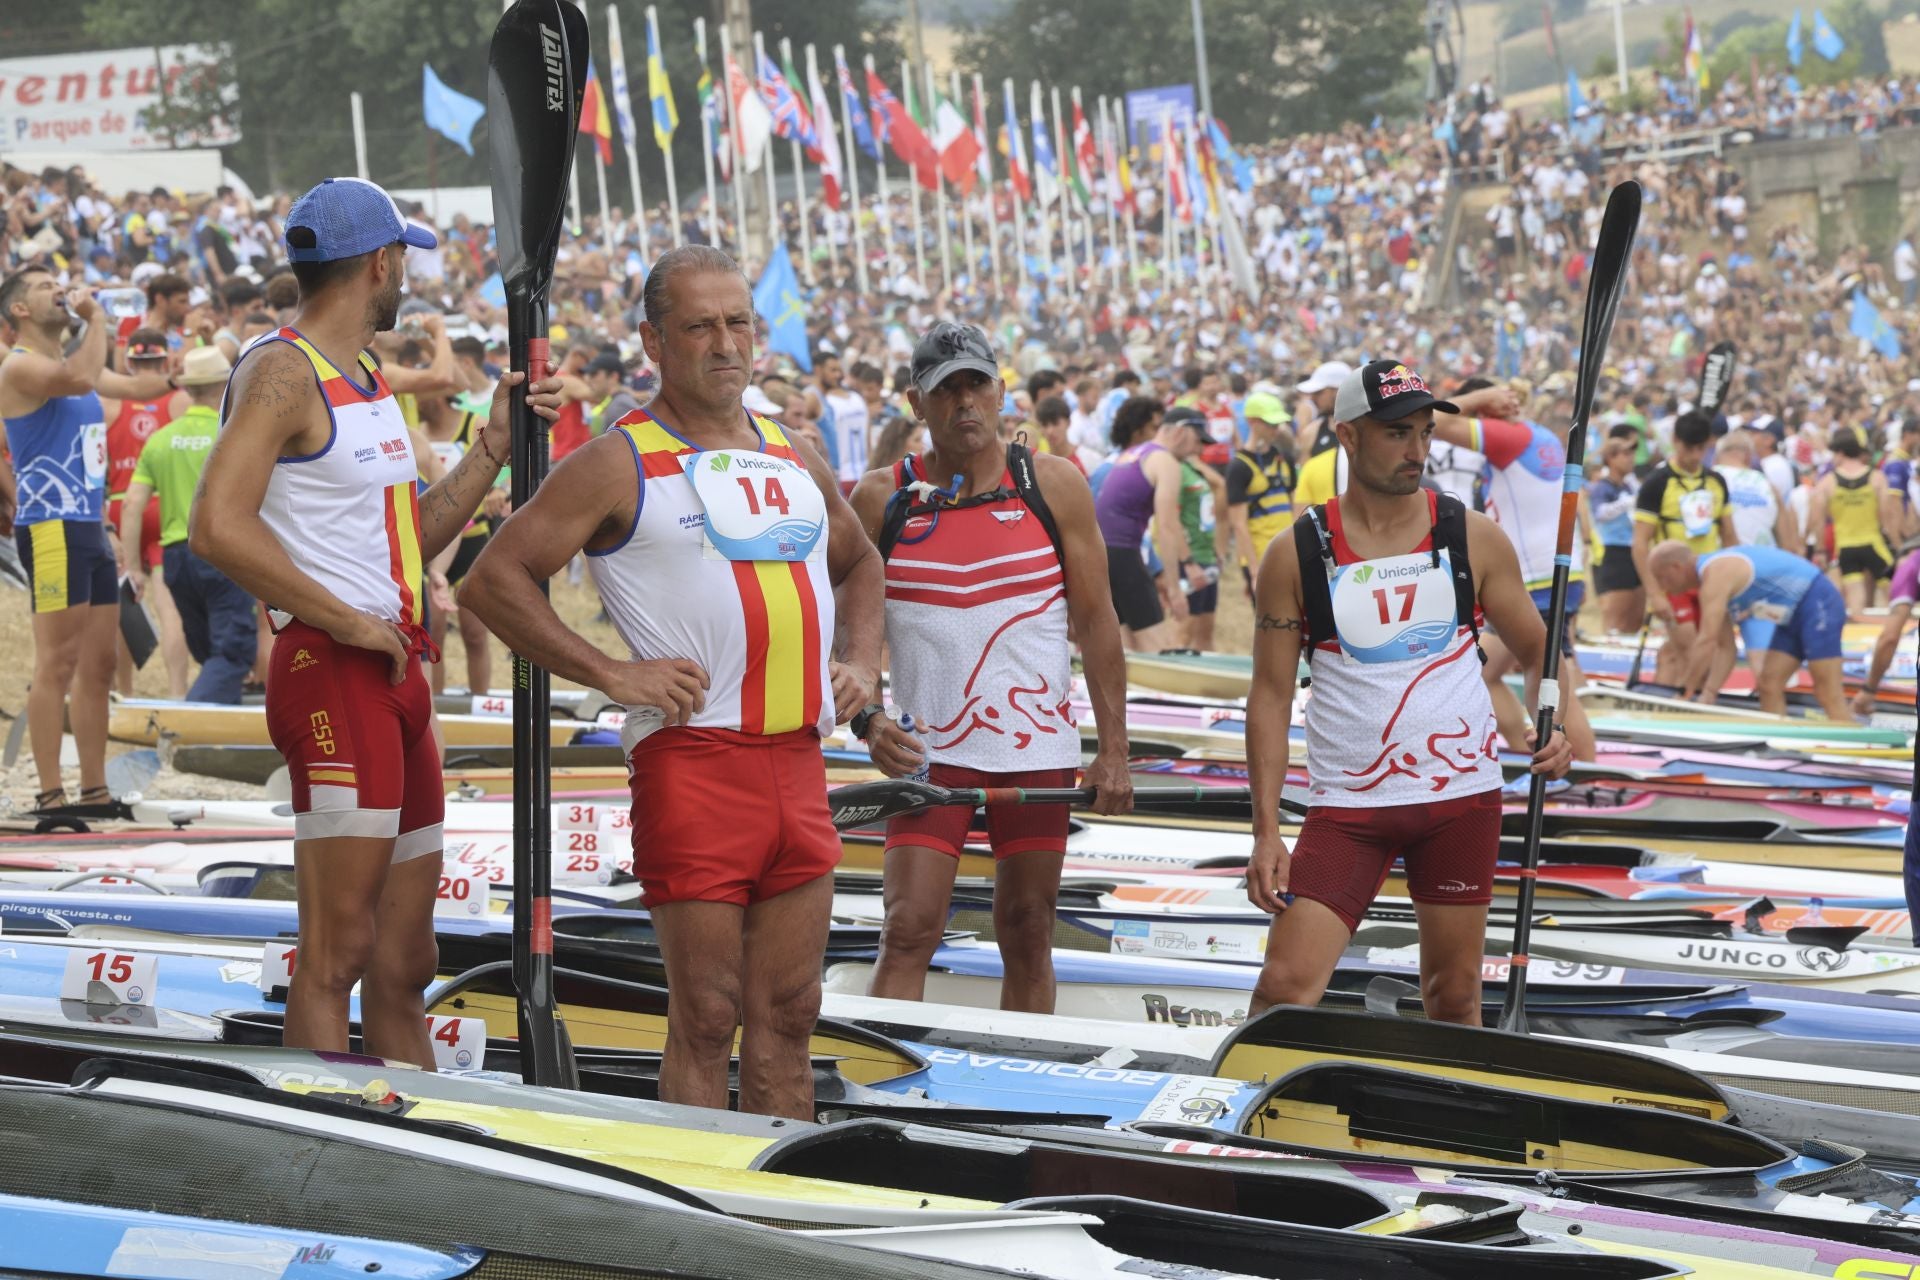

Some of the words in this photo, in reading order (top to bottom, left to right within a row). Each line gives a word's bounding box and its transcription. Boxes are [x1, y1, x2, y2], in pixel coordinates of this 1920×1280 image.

[15, 115, 92, 142] Parque
[97, 110, 126, 135] de
[1379, 378, 1412, 399] Red
[171, 435, 212, 451] RFEP
[735, 458, 785, 473] Unicaja
[736, 477, 789, 515] 14
[1377, 564, 1428, 580] Unicaja
[1372, 583, 1418, 625] 17
[482, 699, 505, 713] 44
[608, 712, 625, 725] 4
[310, 710, 336, 755] ESP
[569, 805, 594, 824] 31
[568, 832, 597, 852] 28
[565, 855, 600, 872] 25
[437, 876, 470, 900] 20
[0, 903, 132, 922] piraguascuesta.eu
[281, 948, 297, 977] 1
[1678, 944, 1787, 968] JUNCO
[87, 953, 134, 983] 15
[927, 1049, 1165, 1086] RODICAR
